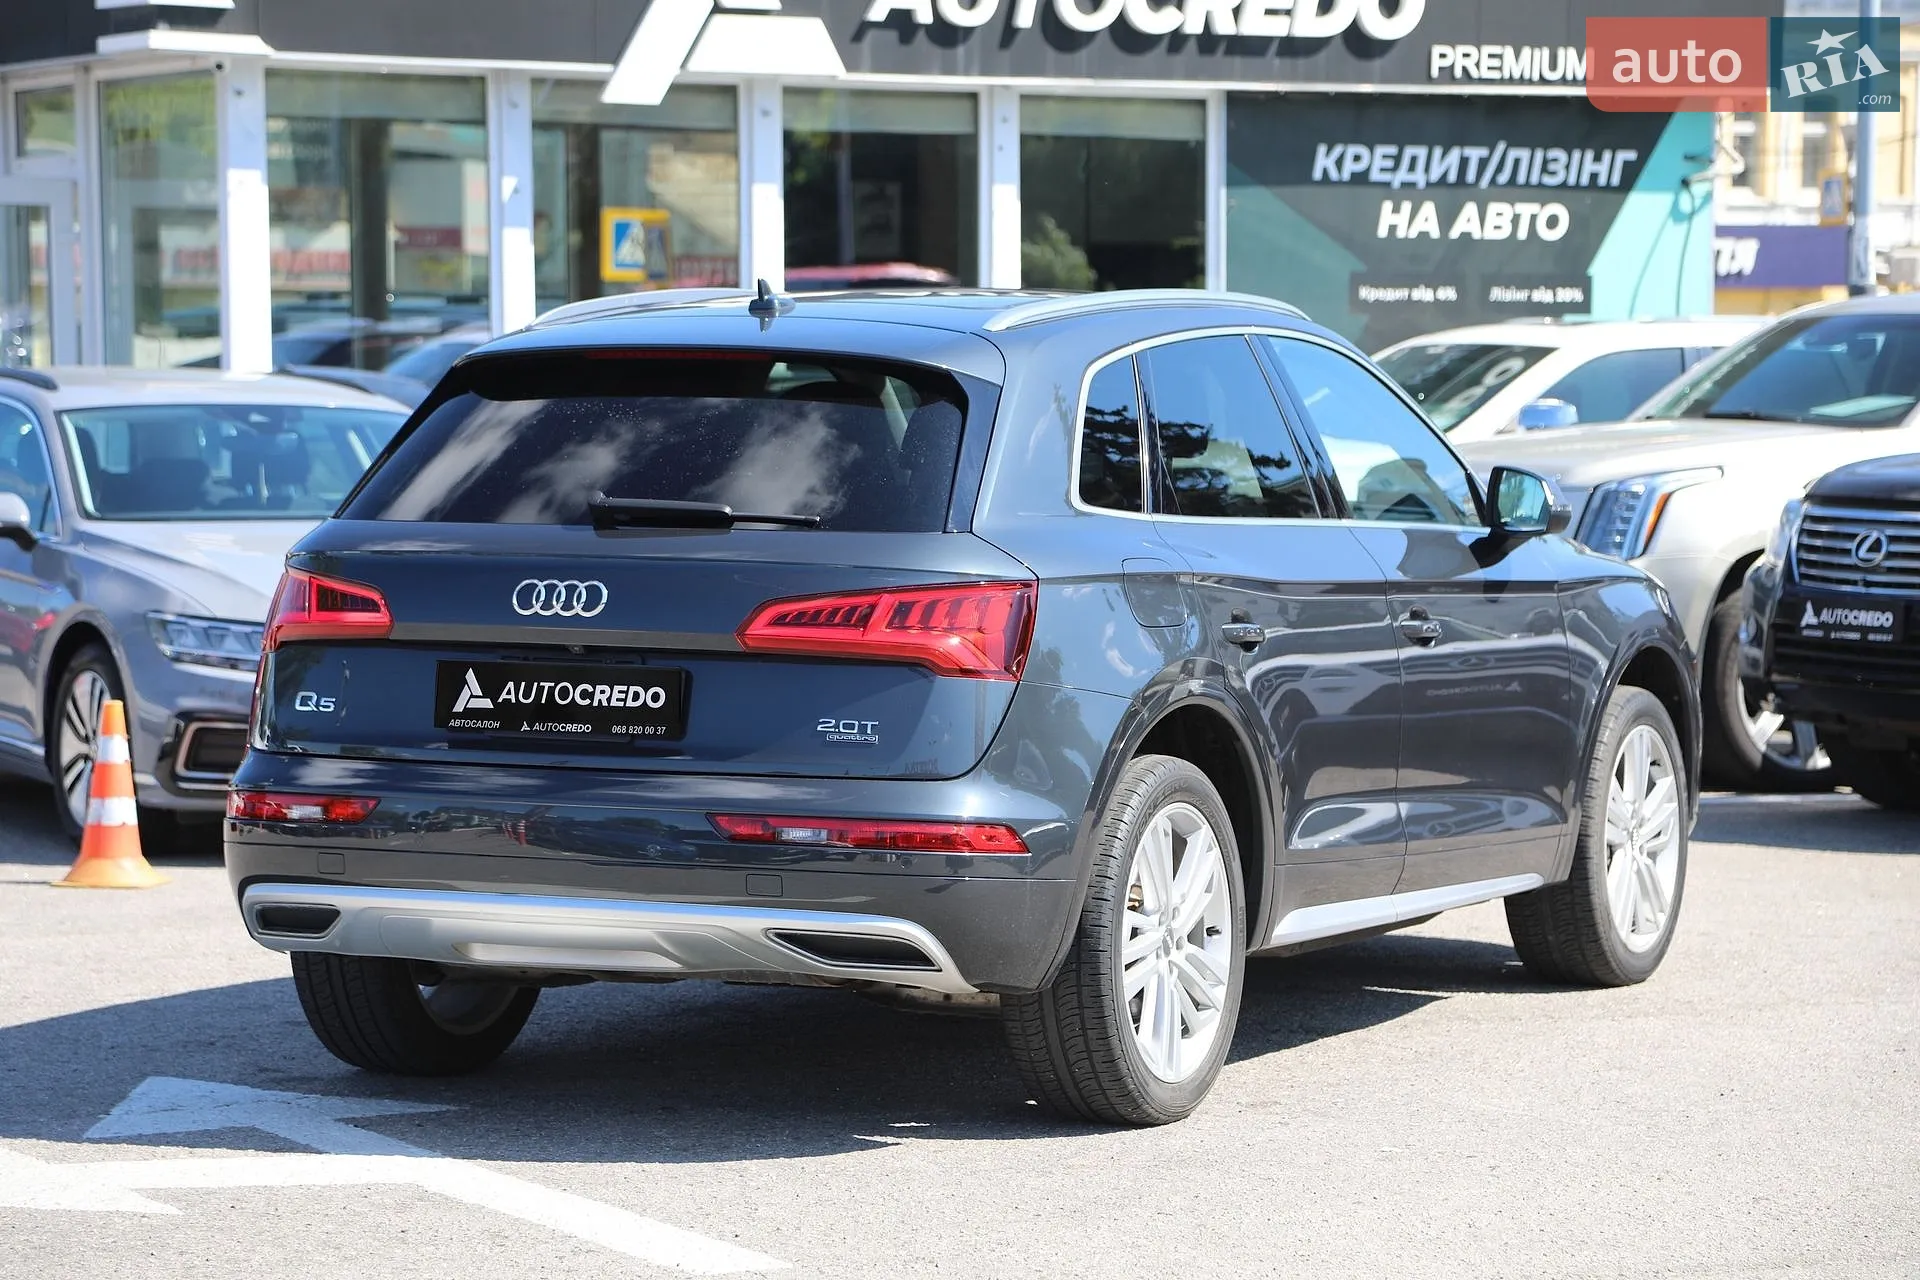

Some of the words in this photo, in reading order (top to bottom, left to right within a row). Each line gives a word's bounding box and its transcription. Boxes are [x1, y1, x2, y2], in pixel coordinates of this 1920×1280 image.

[1430, 44, 1595, 81] PREMIUM
[1311, 139, 1638, 190] КРЕДИТ/ЛІЗІНГ
[1376, 199, 1441, 239] НА
[1448, 200, 1571, 242] АВТО
[1819, 608, 1894, 628] AUTOCREDO
[295, 691, 336, 712] Q5
[497, 681, 666, 709] AUTOCREDO
[448, 718, 501, 729] АВТОСАЛОН
[532, 722, 592, 733] AUTOCREDO
[611, 724, 627, 734] 068
[628, 725, 643, 735] 820
[644, 725, 655, 735] 00
[656, 726, 666, 735] 37
[817, 718, 879, 734] 2.0T
[828, 733, 877, 741] quattro
